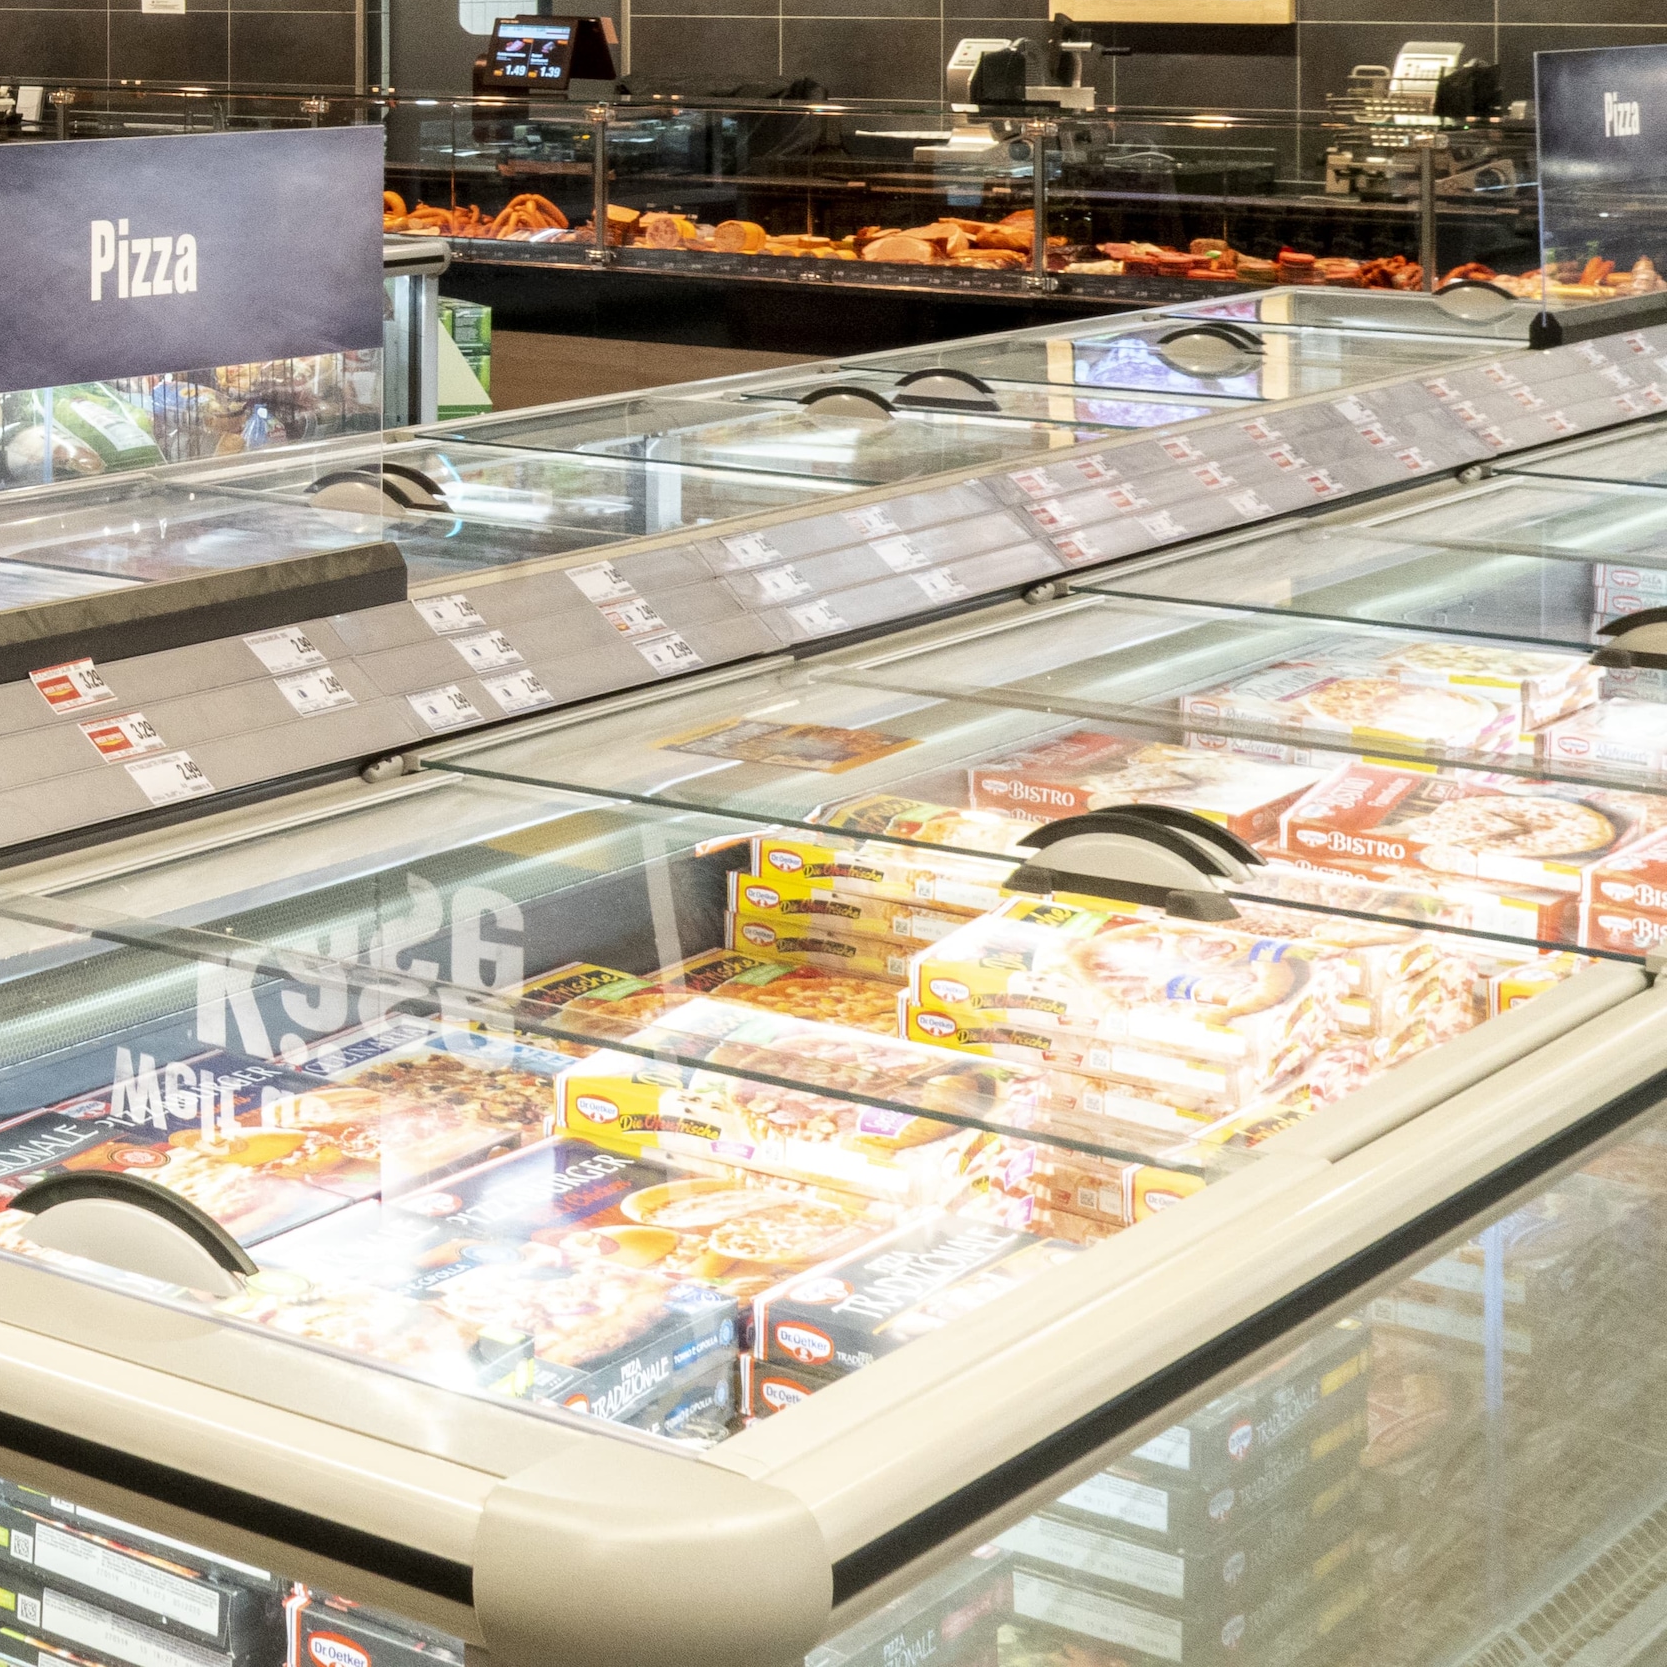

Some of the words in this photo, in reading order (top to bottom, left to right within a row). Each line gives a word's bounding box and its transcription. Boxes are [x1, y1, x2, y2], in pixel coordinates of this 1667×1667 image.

[505, 64, 527, 77] 1.49
[540, 66, 562, 79] 1.39
[1604, 91, 1641, 137] Pizza
[91, 218, 198, 302] Pizza
[289, 636, 315, 655] 2.99
[665, 641, 693, 660] 2.99
[78, 669, 104, 690] 3.29
[318, 675, 344, 695] 2.99
[129, 720, 157, 740] 3.29
[176, 761, 203, 780] 2.99
[1008, 780, 1075, 807] BISTRO
[1327, 832, 1406, 860] BISTRO
[620, 1115, 643, 1130] Die
[831, 1226, 1019, 1319] TRADIZIONALE
[780, 1330, 828, 1352] Dr.Oetker
[620, 1358, 642, 1380] PIZZA
[591, 1359, 669, 1419] TRADIZIONALE
[314, 1640, 366, 1667] Dr.Oetker
